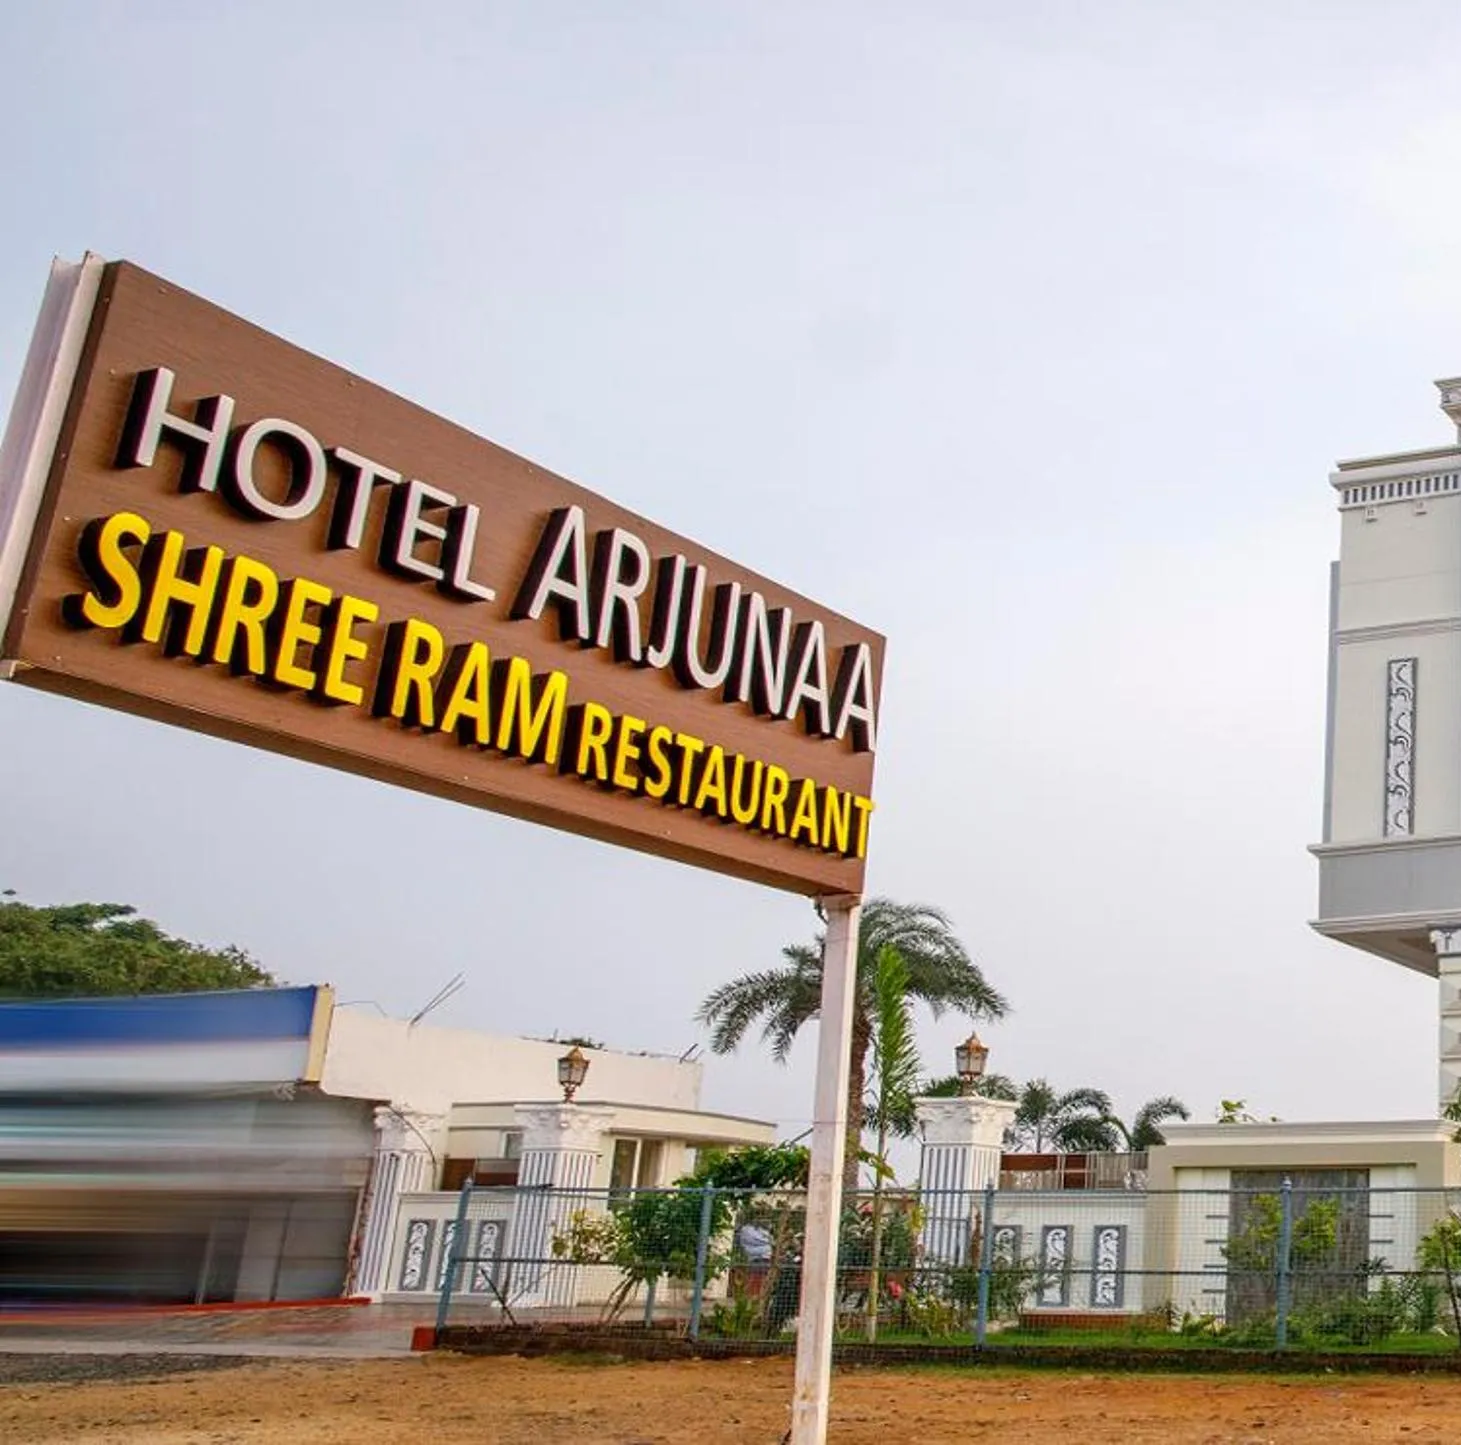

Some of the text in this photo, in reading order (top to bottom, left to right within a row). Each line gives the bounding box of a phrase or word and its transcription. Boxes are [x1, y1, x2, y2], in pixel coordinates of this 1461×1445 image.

[82, 512, 875, 859] SHREE RAM RESTAURANT
[132, 366, 878, 751] HOTEL ARJUNAA
